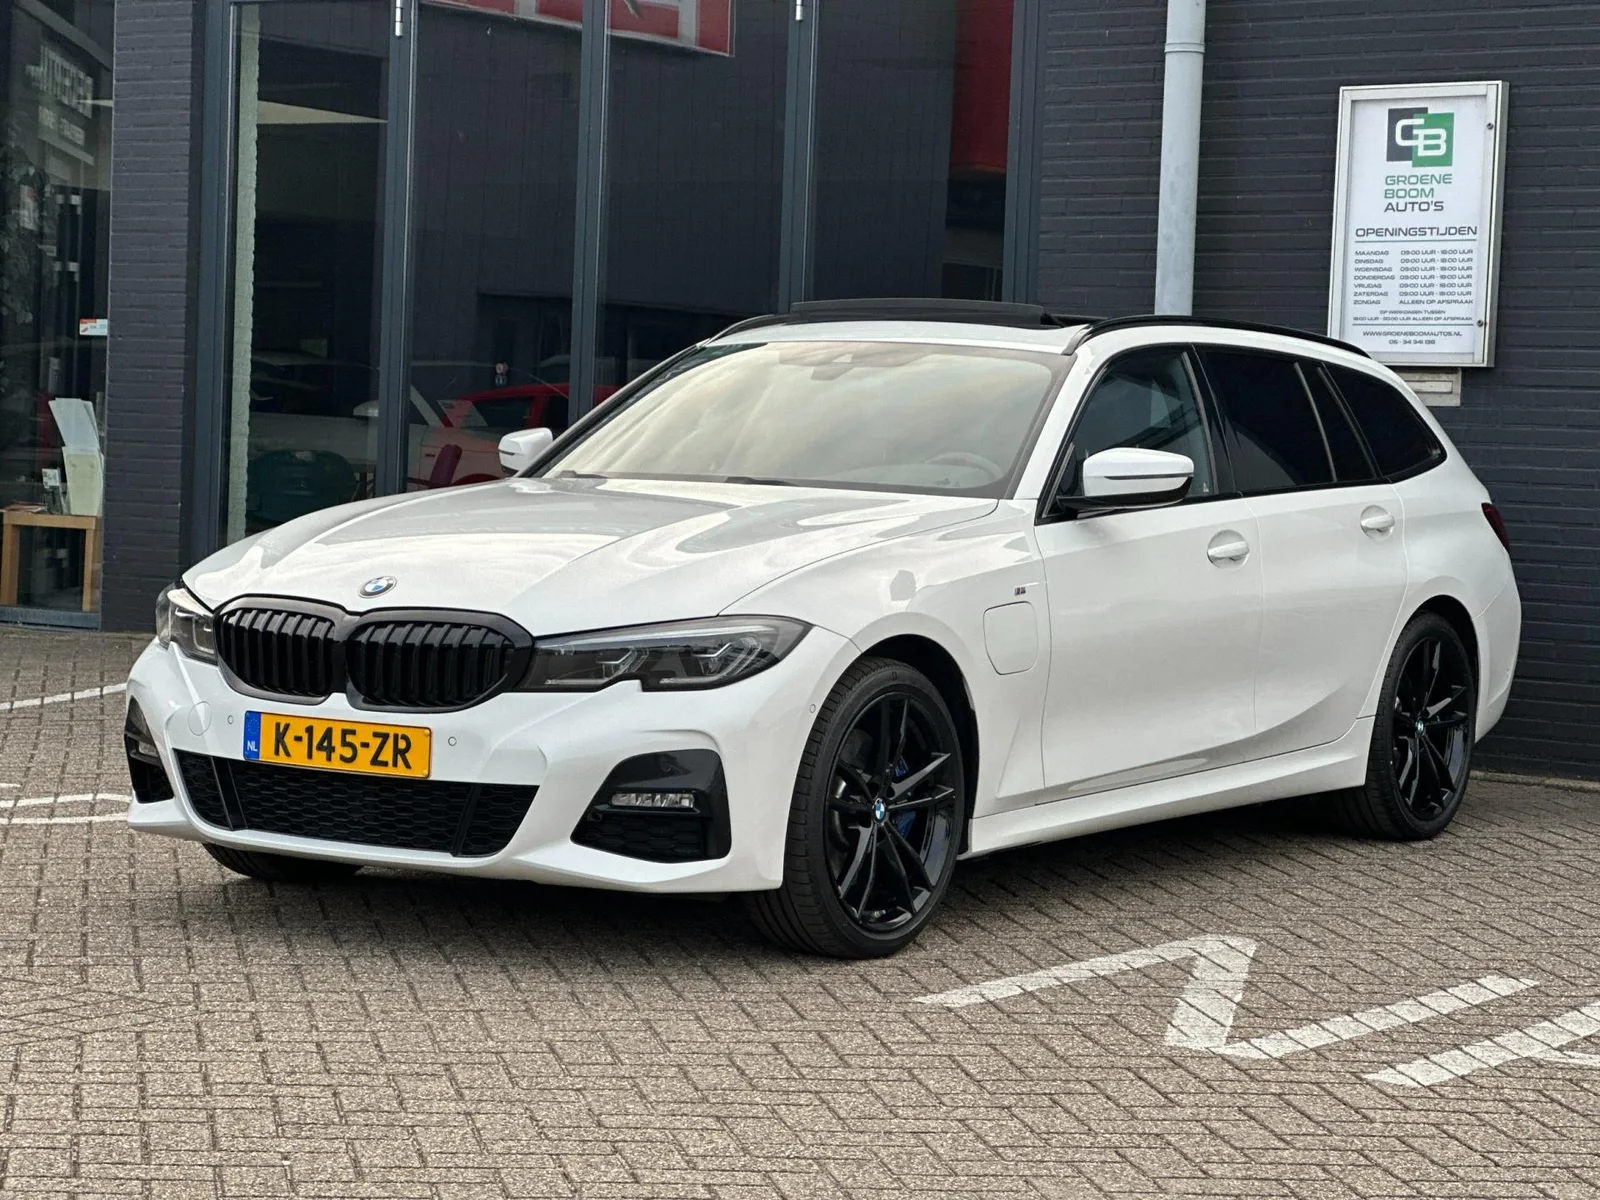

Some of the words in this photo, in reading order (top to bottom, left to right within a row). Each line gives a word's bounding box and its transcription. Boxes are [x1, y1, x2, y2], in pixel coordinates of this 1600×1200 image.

[1385, 173, 1453, 186] GROENE
[1384, 187, 1434, 199] BOOM
[1384, 200, 1444, 213] AUTO'S
[1355, 226, 1477, 237] OPENINGSTIJDEN
[246, 741, 258, 752] NL
[273, 722, 412, 770] K-145-ZR
